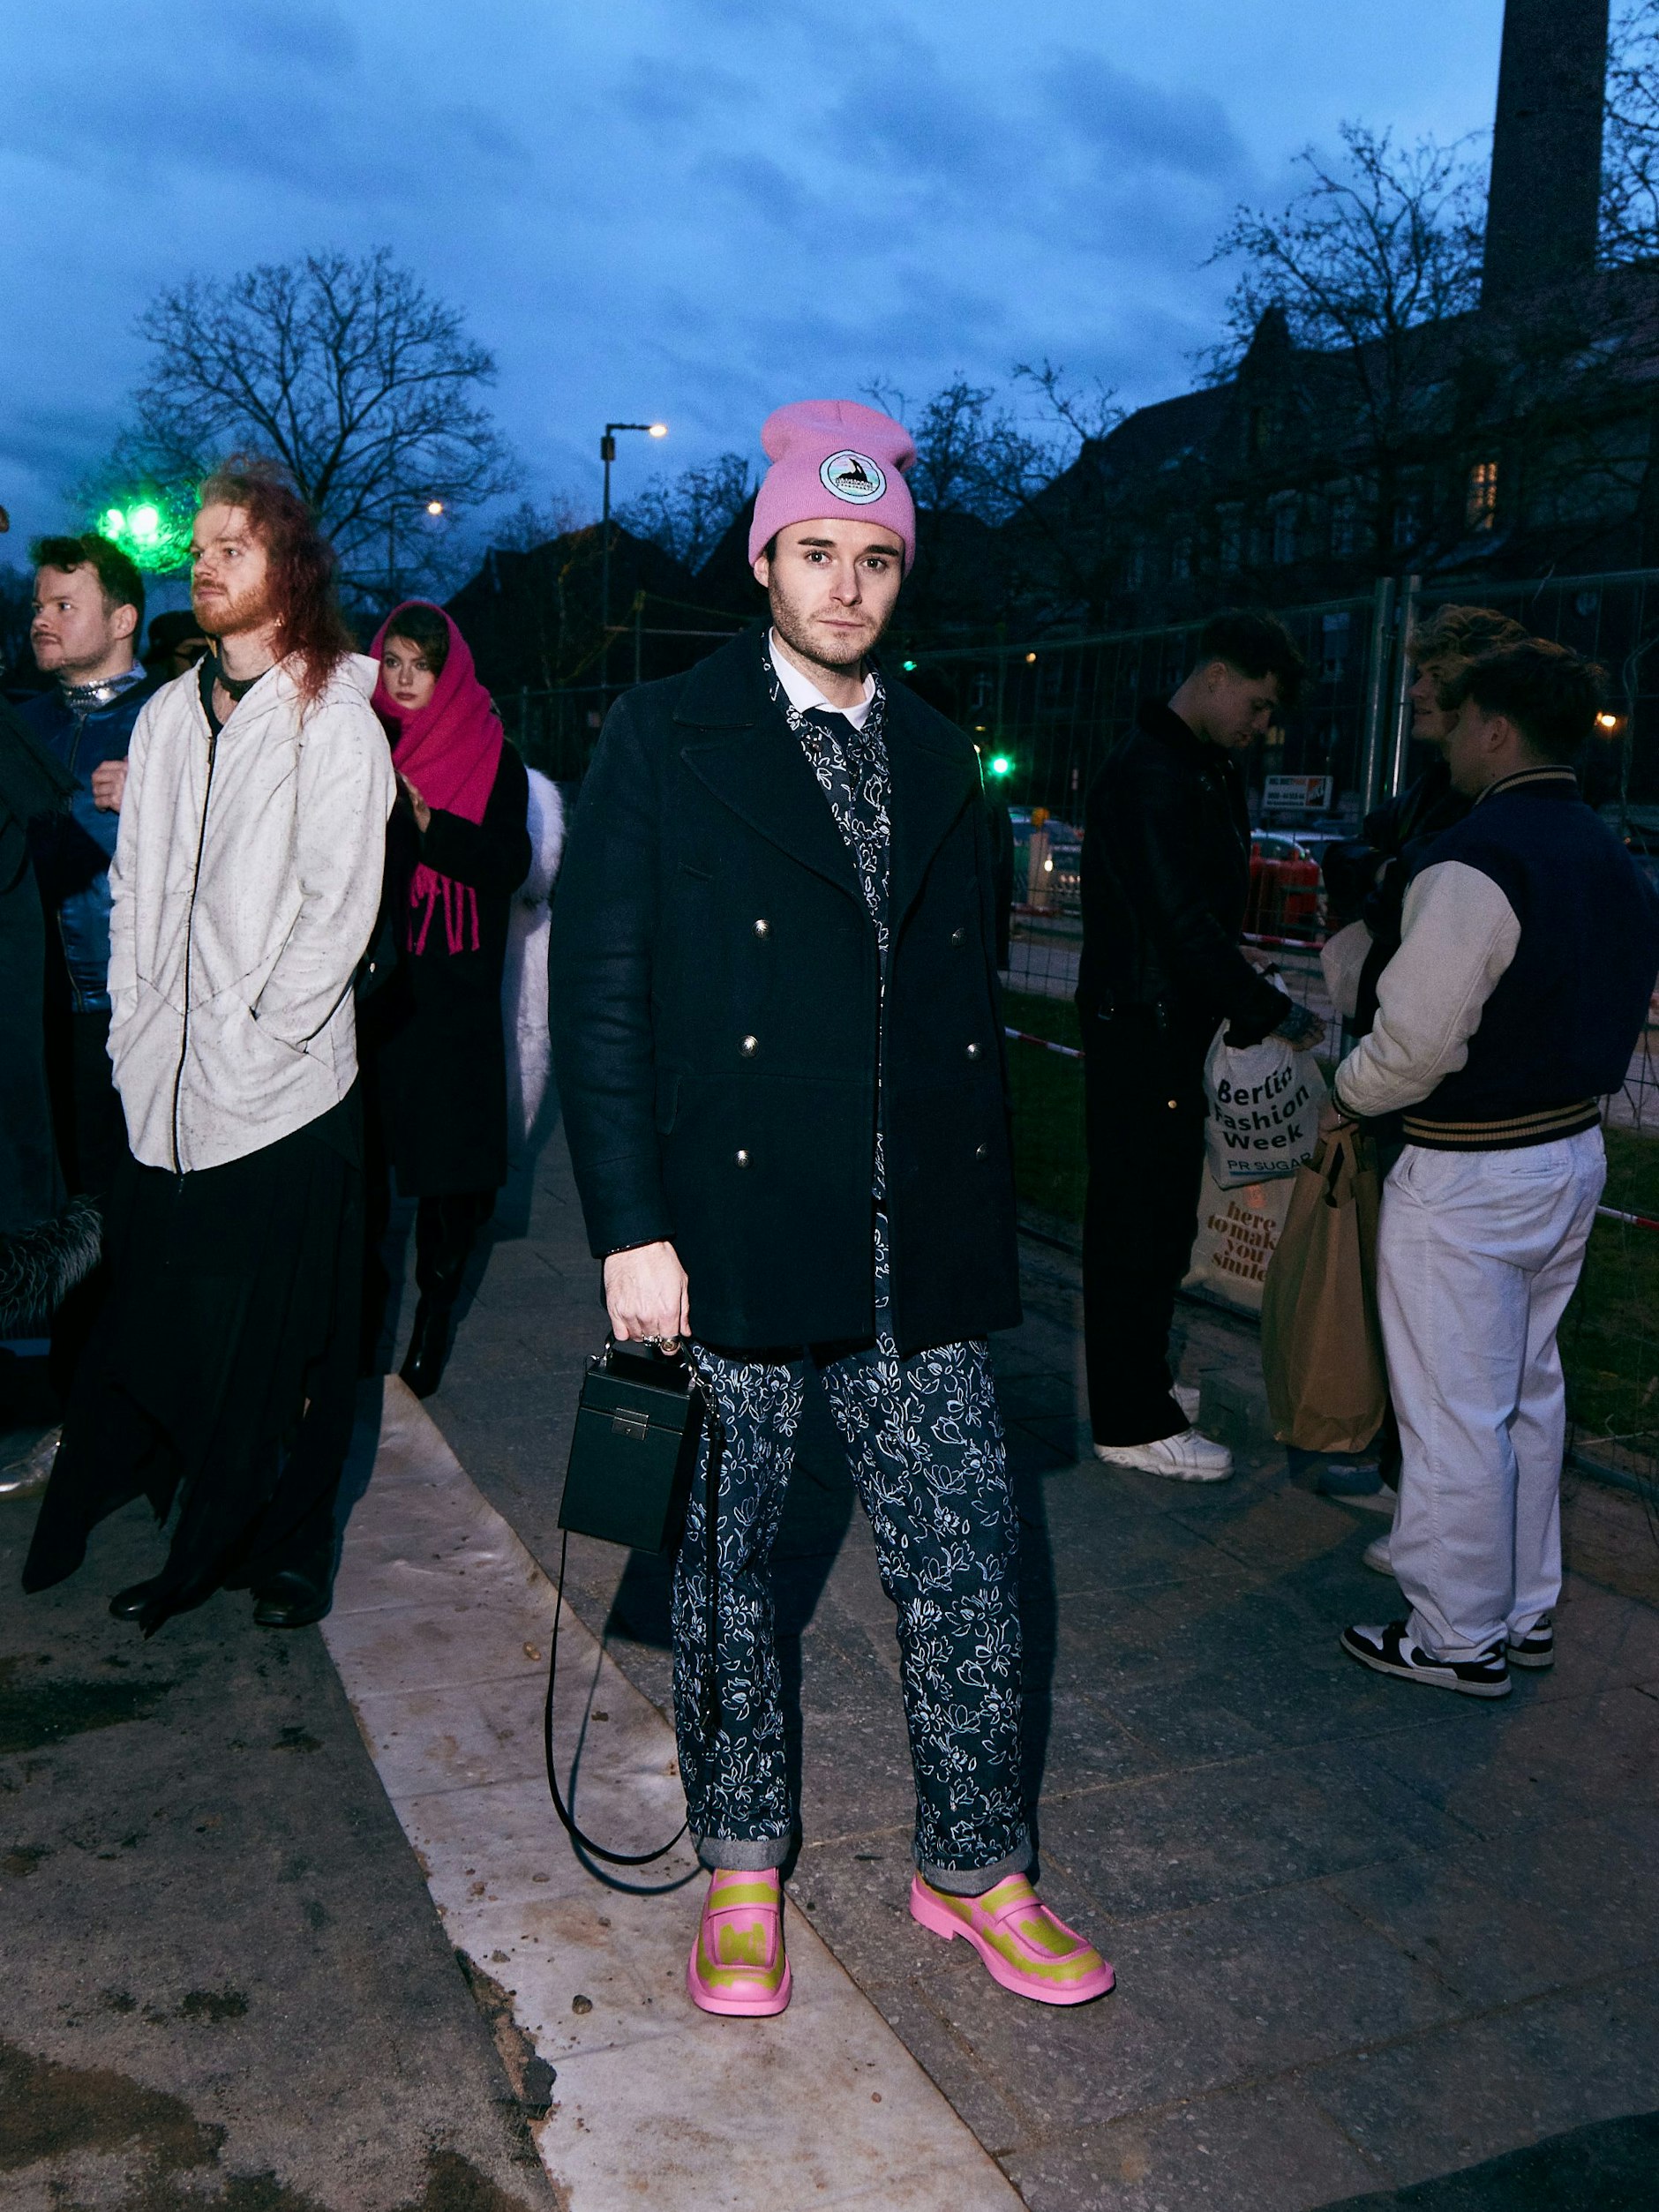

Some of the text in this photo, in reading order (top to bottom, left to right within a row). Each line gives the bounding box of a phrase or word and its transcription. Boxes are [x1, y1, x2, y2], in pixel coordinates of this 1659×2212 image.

[1219, 1066, 1292, 1106] Berlin
[1214, 1084, 1310, 1130] Fashion
[1223, 1123, 1303, 1150] Week
[1227, 1158, 1250, 1170] PR
[1227, 1201, 1276, 1232] here
[1207, 1215, 1275, 1251] to mak
[1224, 1239, 1264, 1263] you
